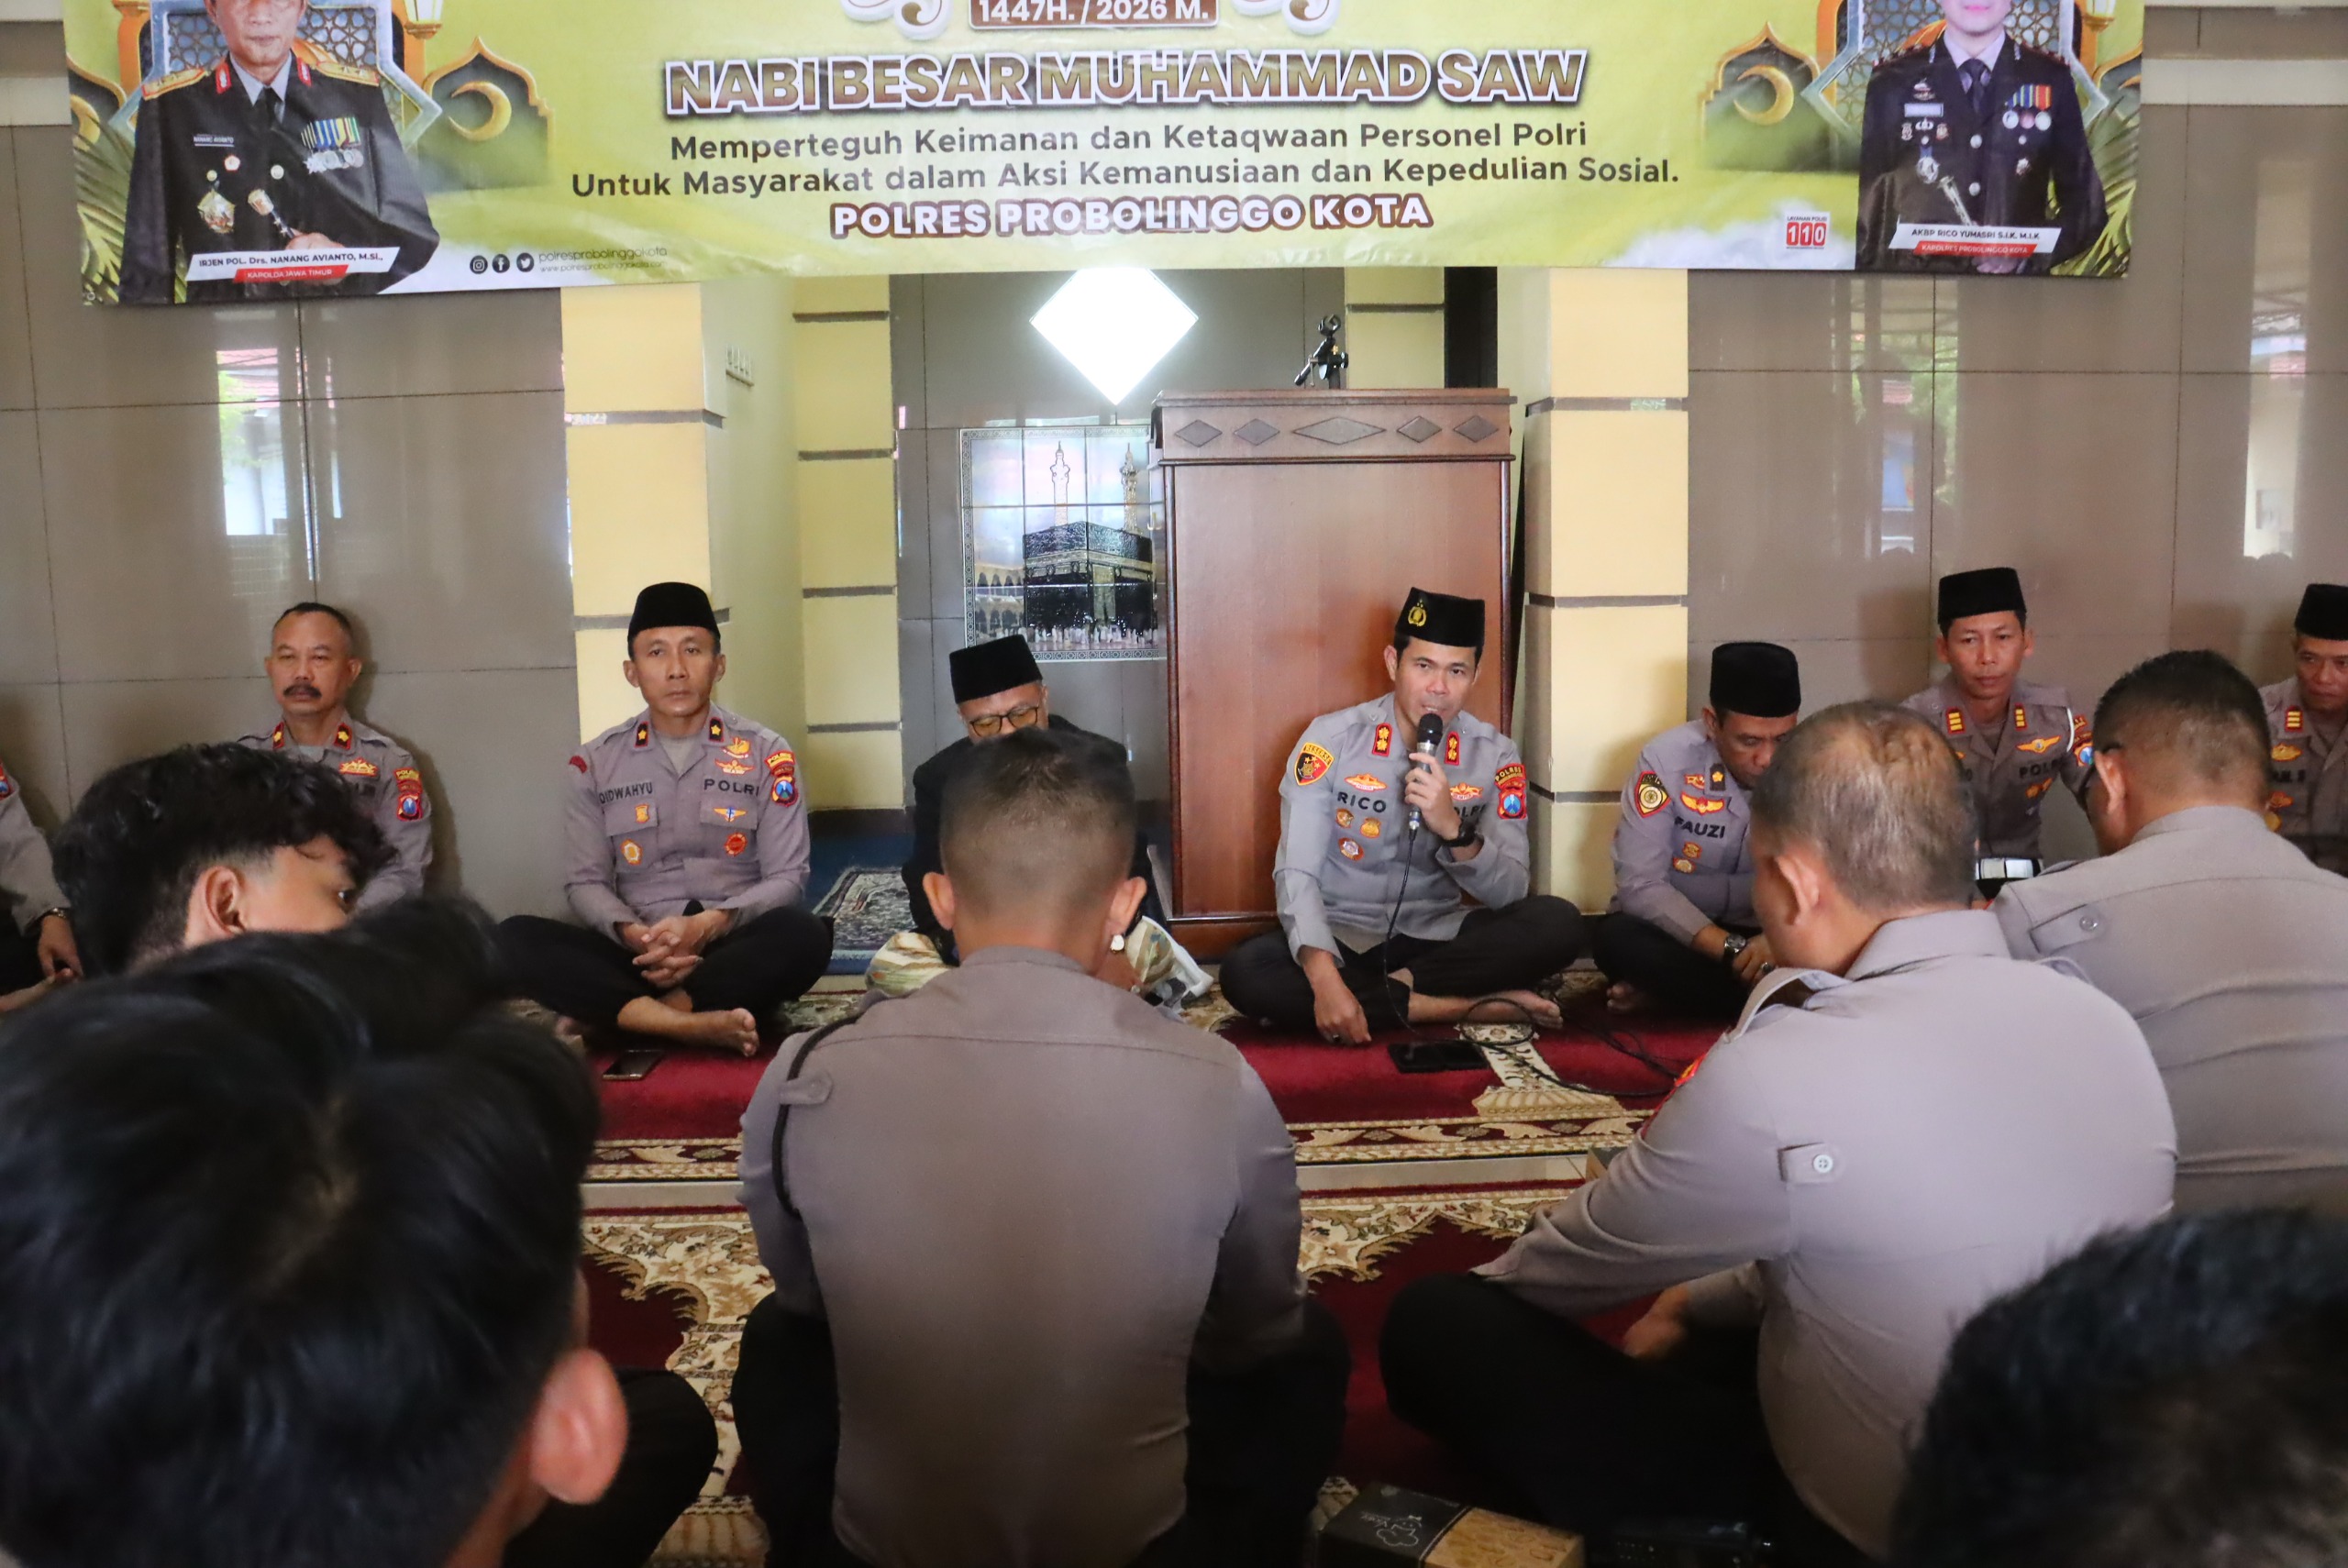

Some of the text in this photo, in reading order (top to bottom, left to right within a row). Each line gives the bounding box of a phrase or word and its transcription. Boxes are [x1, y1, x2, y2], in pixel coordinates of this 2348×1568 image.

[979, 0, 1075, 22] 1447H.
[1096, 0, 1168, 20] 2026
[1174, 0, 1209, 19] M.
[665, 49, 1588, 115] NABI BESAR MUHAMMAD SAW
[671, 122, 1586, 160] Memperteguh Keimanan dan Ketaqwaan Personel Polri
[572, 157, 1679, 199] Untuk Masyarakat dalam Aksi Kemanusiaan dan Kepedulian Sosial.
[832, 193, 1433, 237] POLRES PROBOLINGGO KOTA
[1788, 224, 1826, 245] 110
[1911, 228, 1934, 237] AKBP
[1960, 229, 1996, 238] YUMASRI
[271, 255, 310, 263] NANANG
[312, 253, 356, 263] AVIANTO,
[538, 247, 668, 263] polresprobolinggokota
[247, 271, 285, 279] KAPOLDA
[704, 778, 760, 797] POLRI
[1337, 791, 1387, 813] RICO
[1674, 815, 1726, 839] FAUZI
